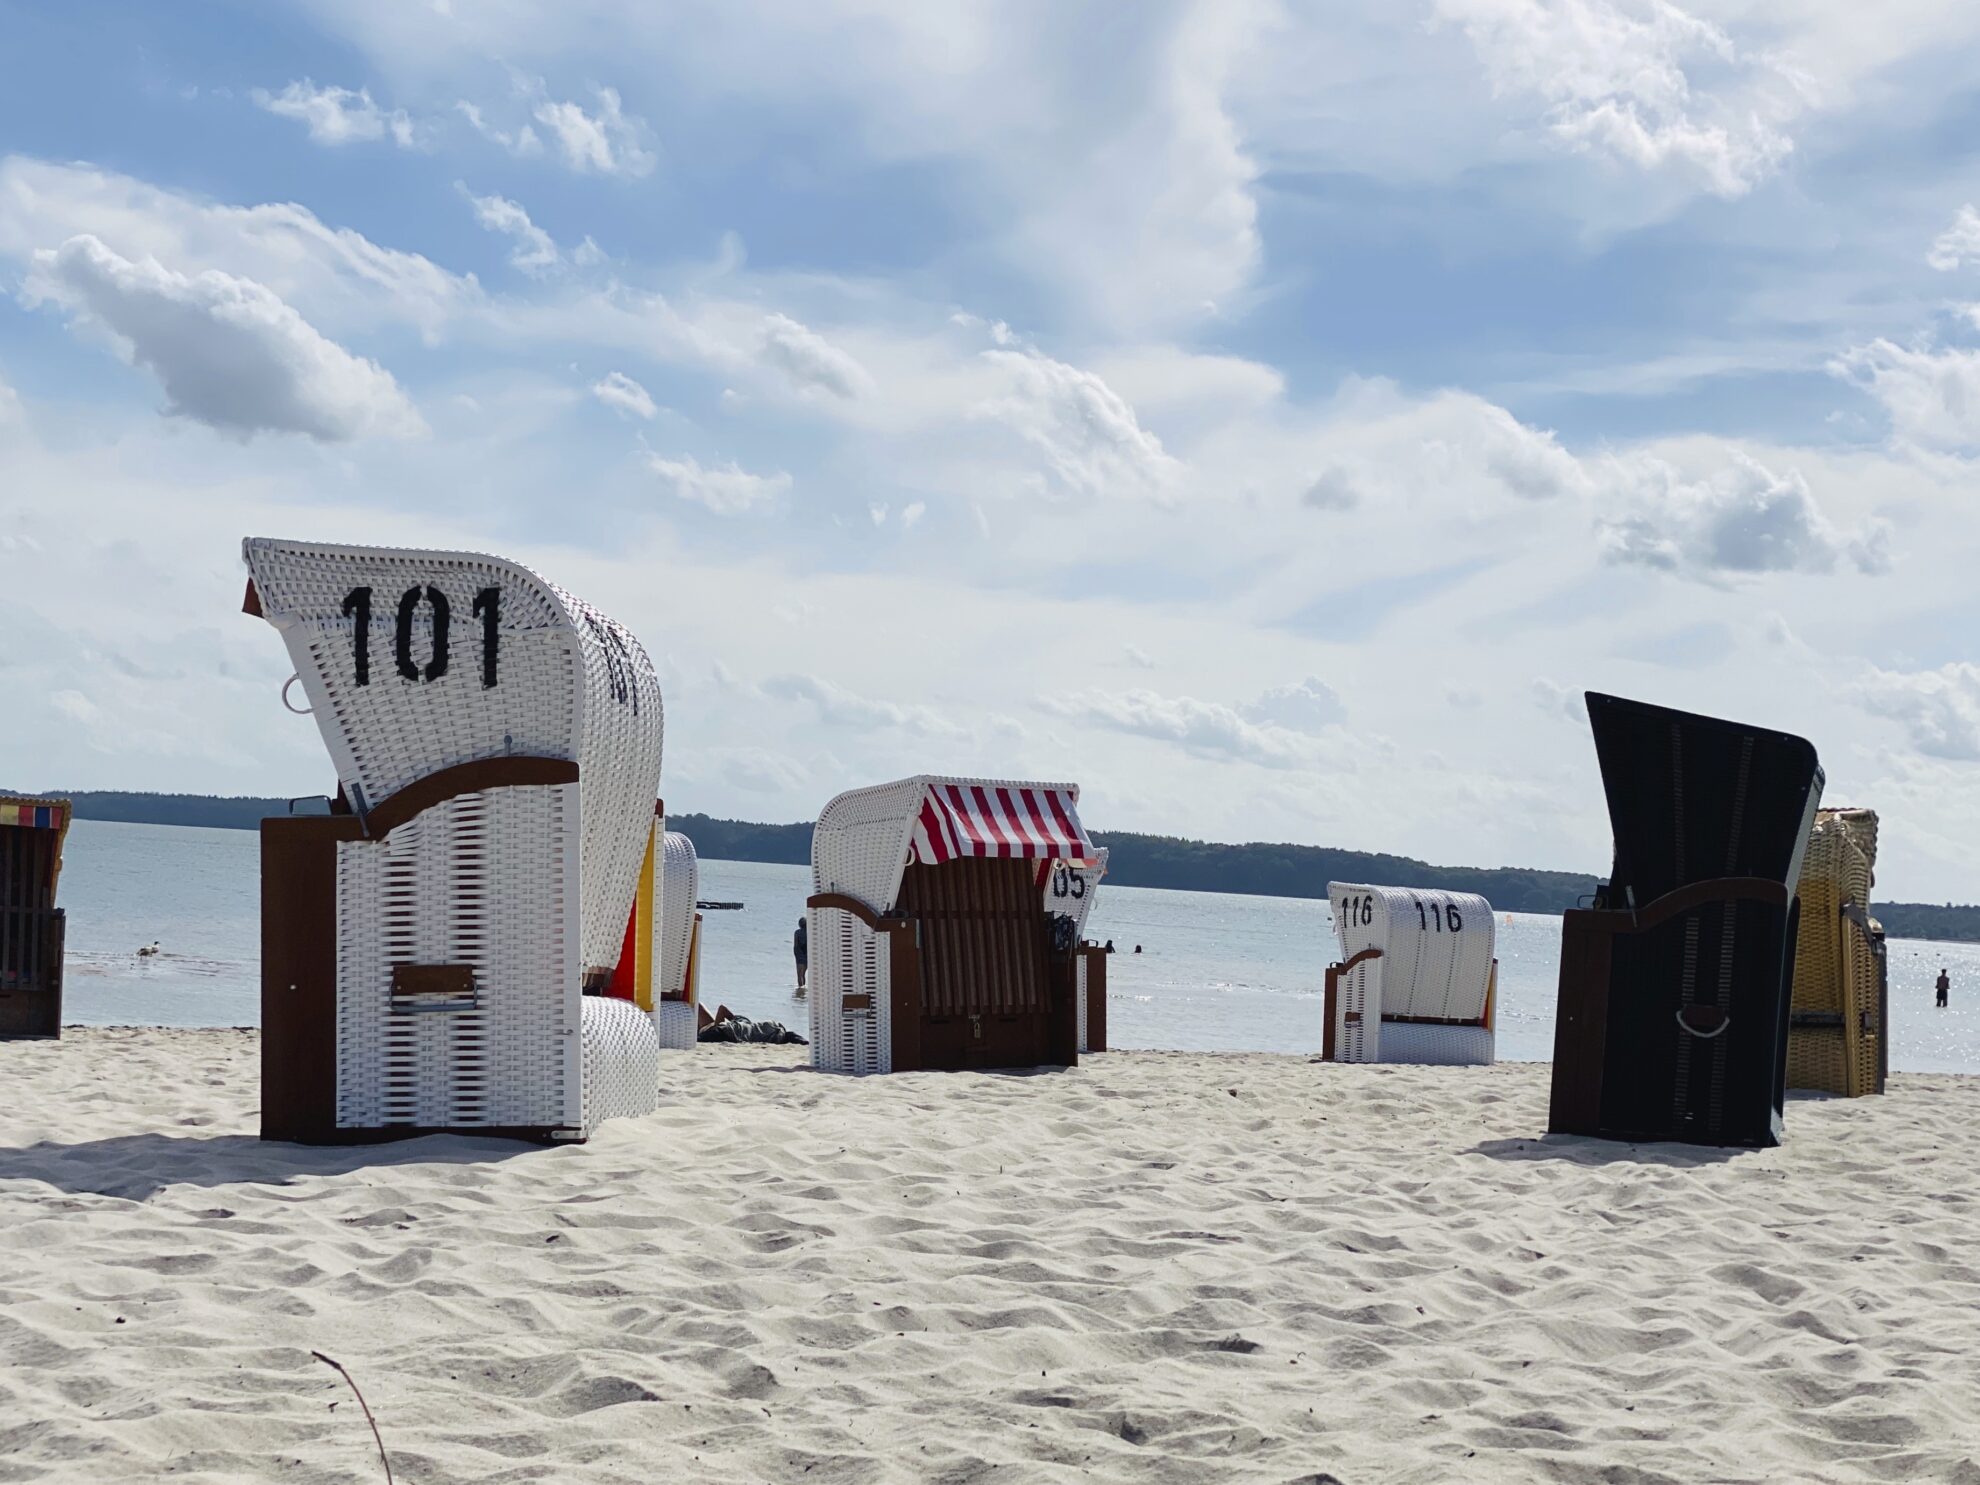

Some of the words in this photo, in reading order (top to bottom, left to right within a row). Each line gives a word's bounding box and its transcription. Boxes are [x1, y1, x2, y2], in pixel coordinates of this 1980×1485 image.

[343, 585, 501, 688] 101
[1342, 895, 1373, 928] 116
[1415, 901, 1462, 932] 116
